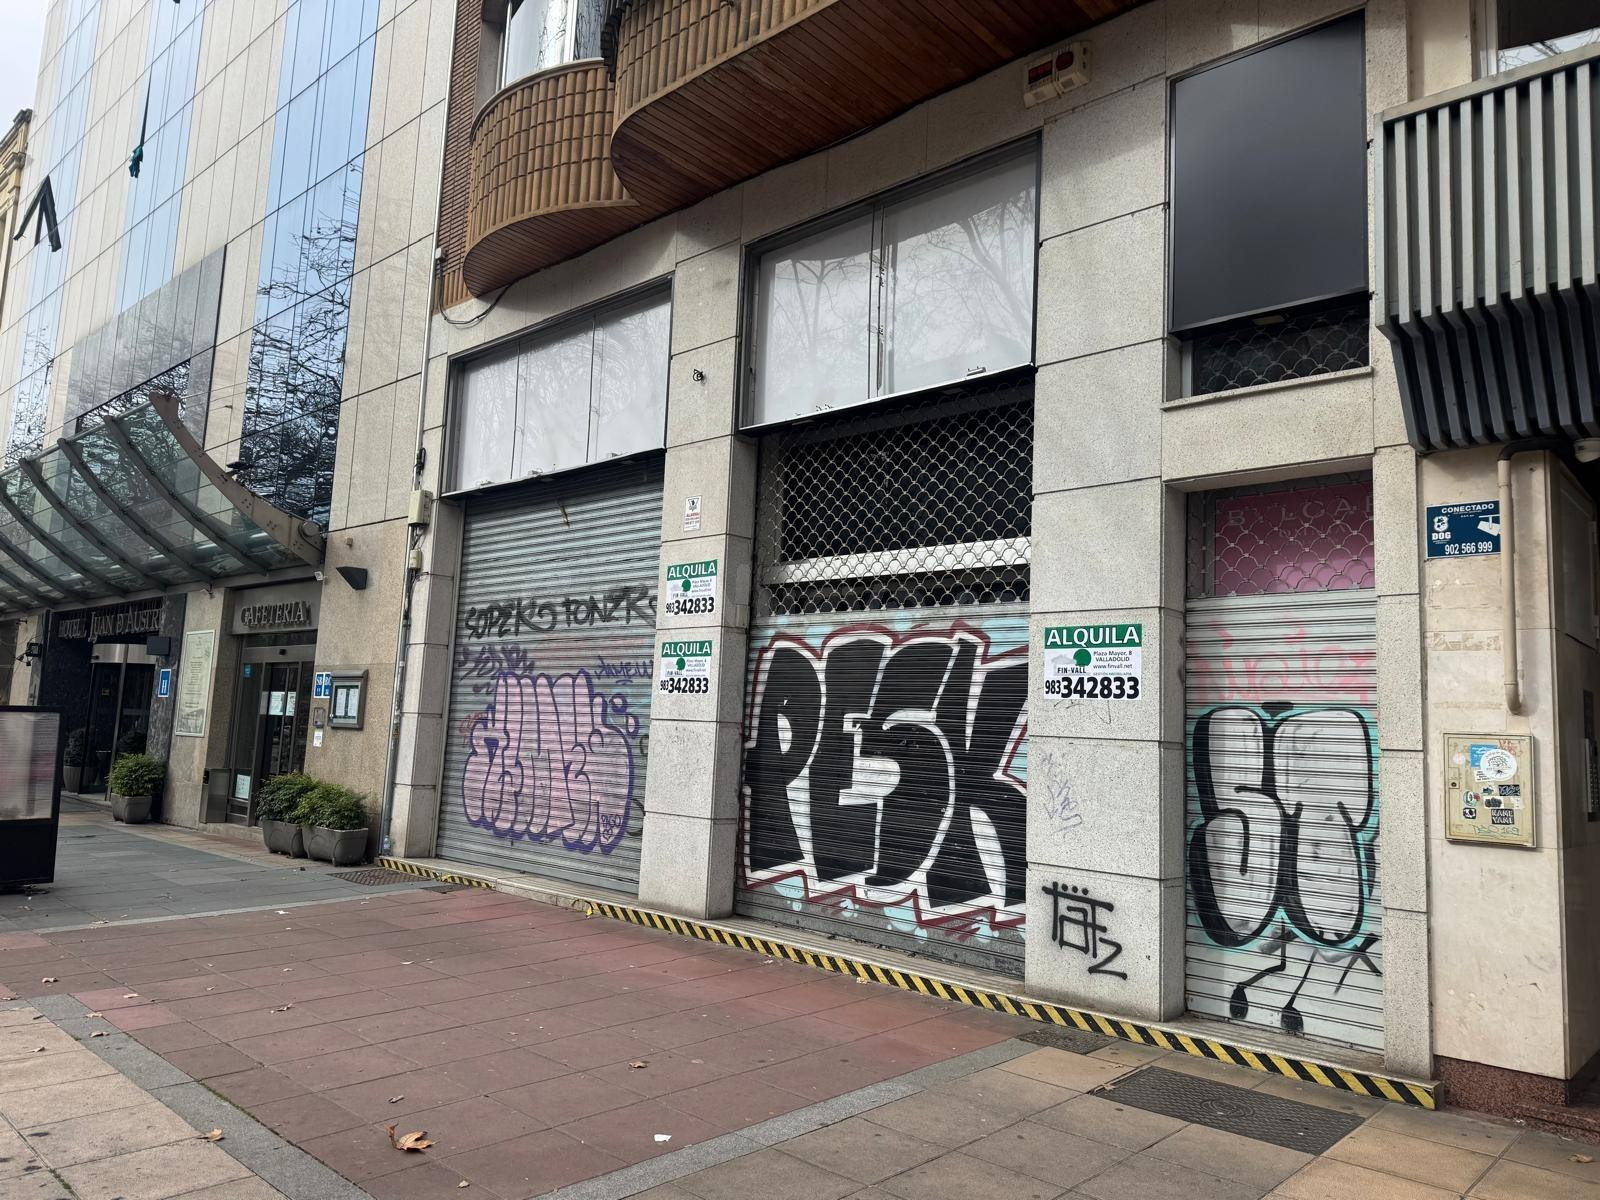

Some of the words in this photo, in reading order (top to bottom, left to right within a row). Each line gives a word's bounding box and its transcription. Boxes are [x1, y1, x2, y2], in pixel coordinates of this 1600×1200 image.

[1441, 503, 1495, 514] CONECTADO
[1431, 532, 1451, 540] DOG
[1444, 543, 1459, 555] 902
[1461, 542, 1476, 554] 566
[1477, 541, 1493, 553] 999
[668, 562, 716, 579] ALQUILA
[1046, 626, 1140, 648] ALQUILA
[662, 642, 711, 657] ALQUILA
